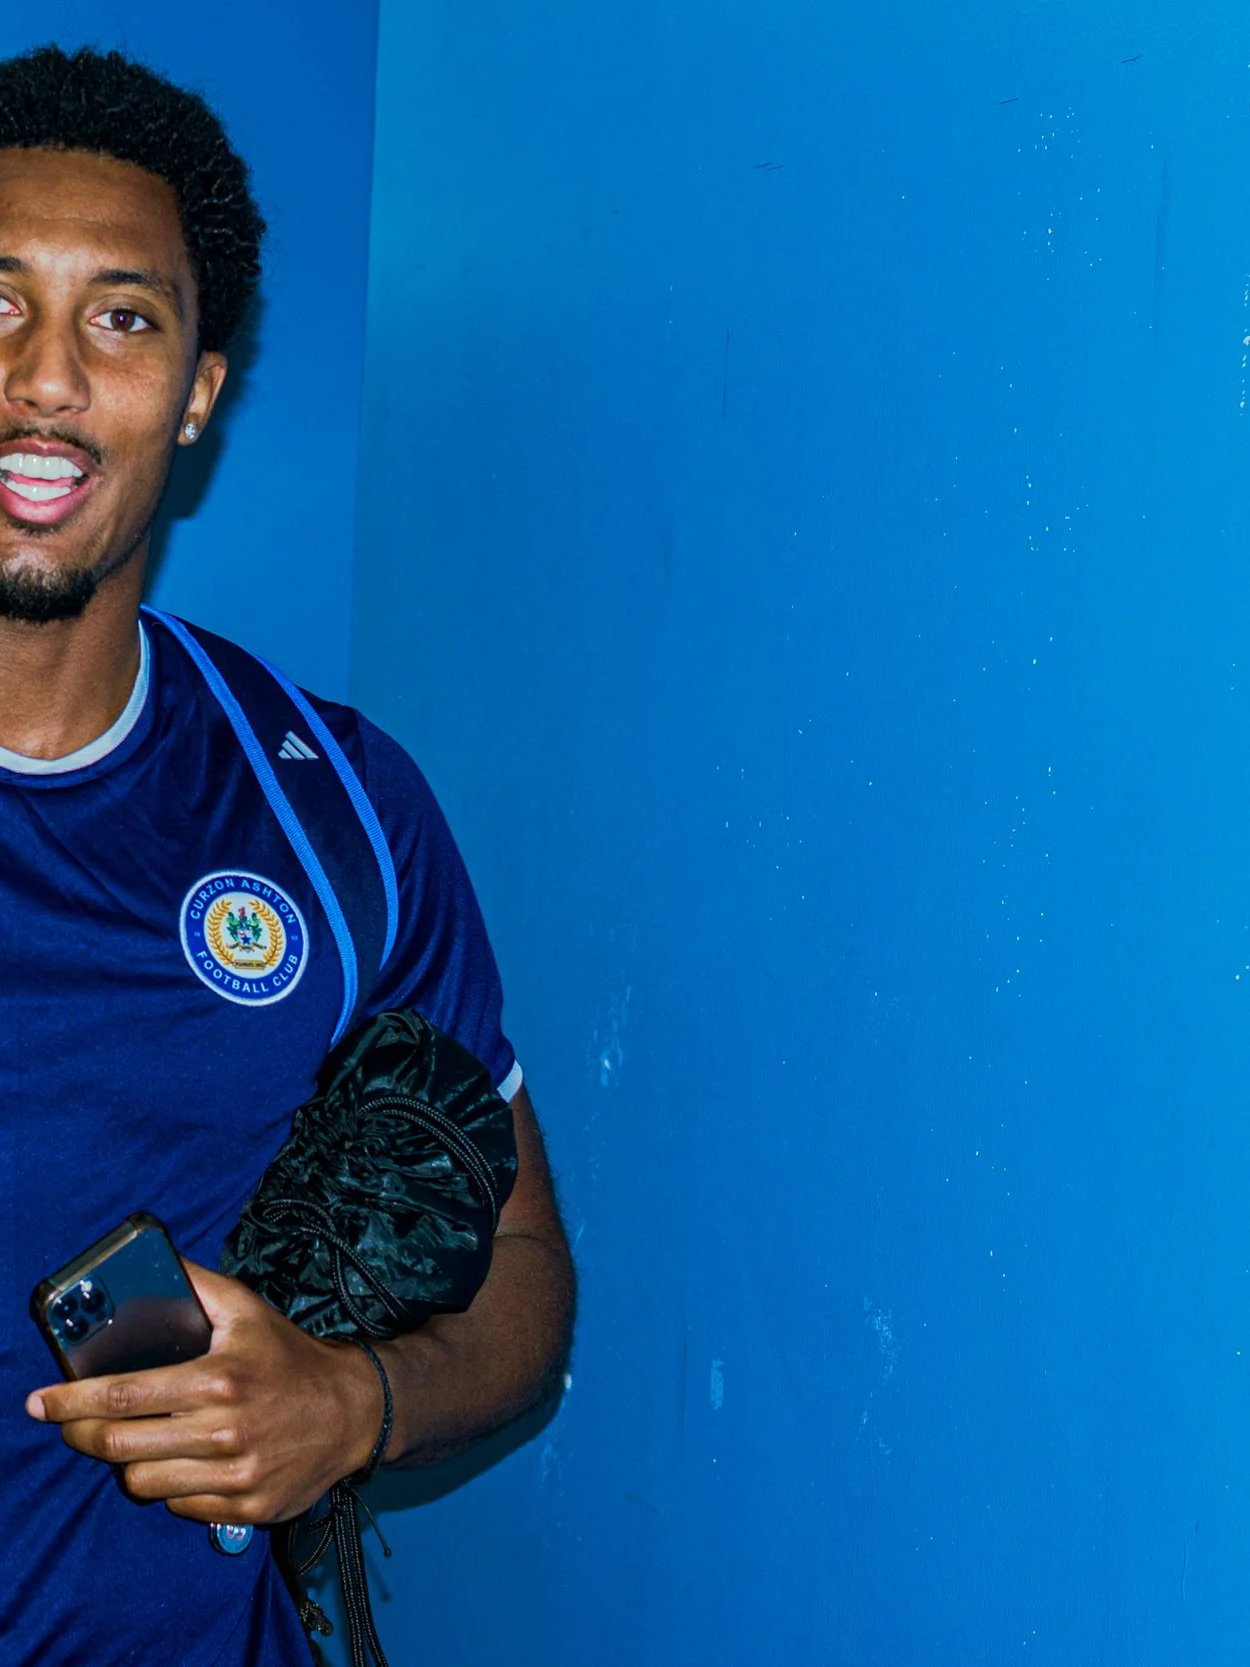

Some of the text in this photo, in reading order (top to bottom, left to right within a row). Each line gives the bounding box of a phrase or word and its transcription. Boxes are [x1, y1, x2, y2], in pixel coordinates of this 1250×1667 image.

[190, 878, 297, 924] CURZON ASHTON
[197, 951, 299, 994] FOOTBALL CLUB
